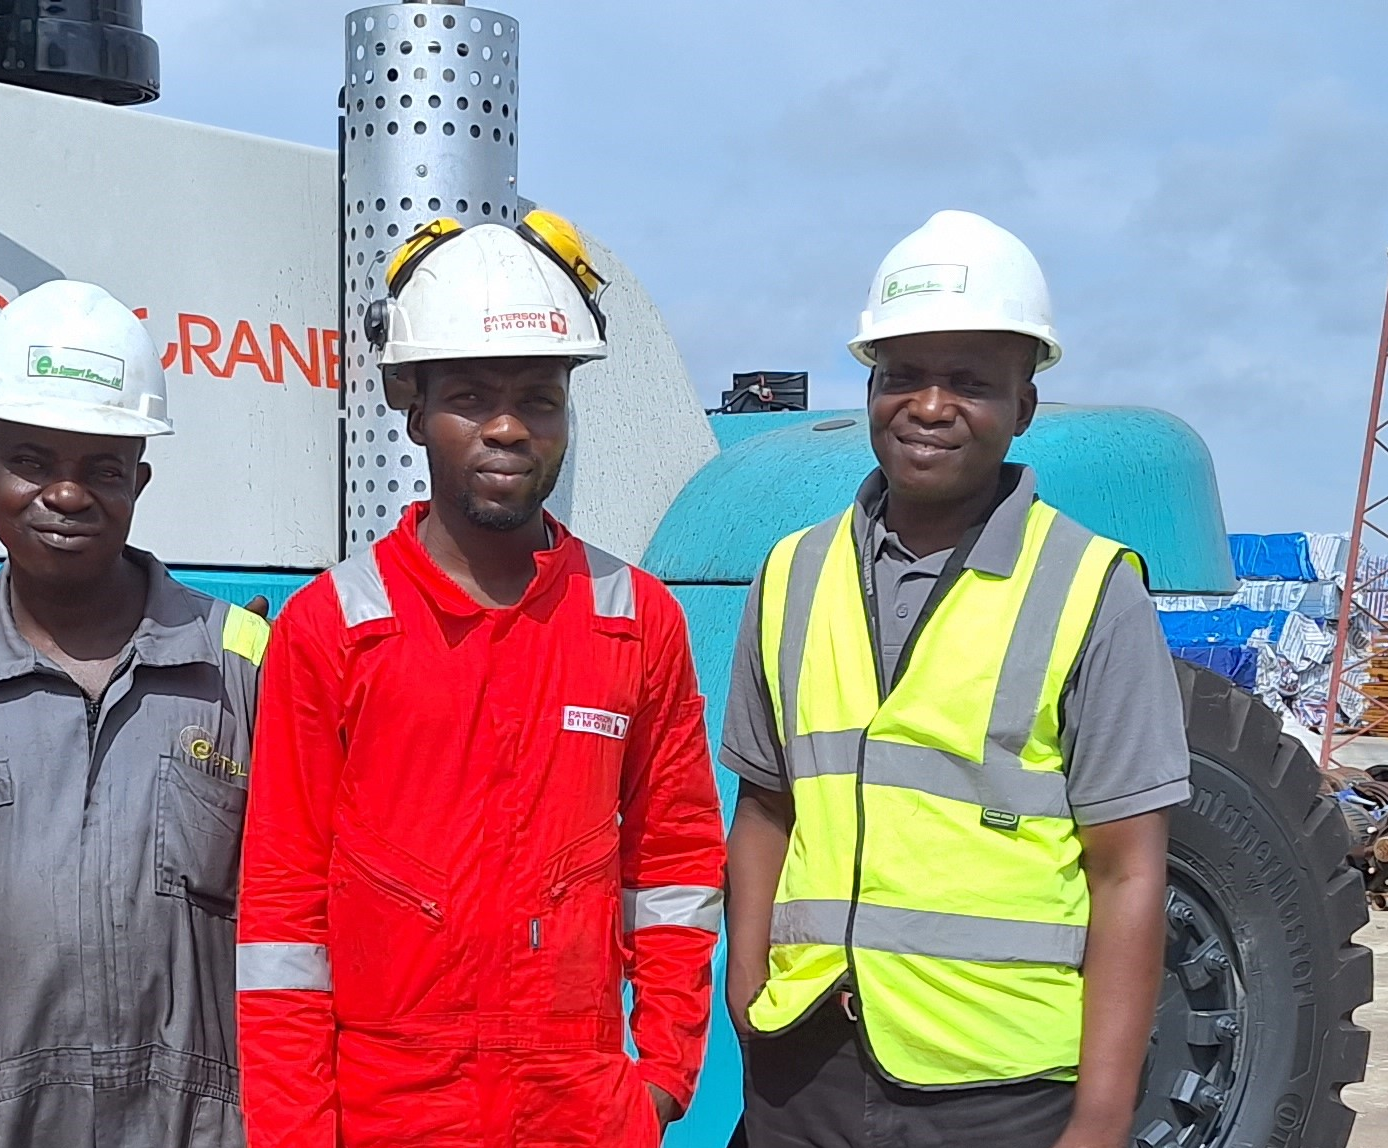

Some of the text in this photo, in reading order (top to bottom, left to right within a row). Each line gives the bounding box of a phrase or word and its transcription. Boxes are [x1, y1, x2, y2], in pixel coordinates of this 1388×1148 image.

[484, 312, 546, 324] PATERSON
[484, 320, 547, 333] SIMONS
[567, 718, 612, 732] SIMONS
